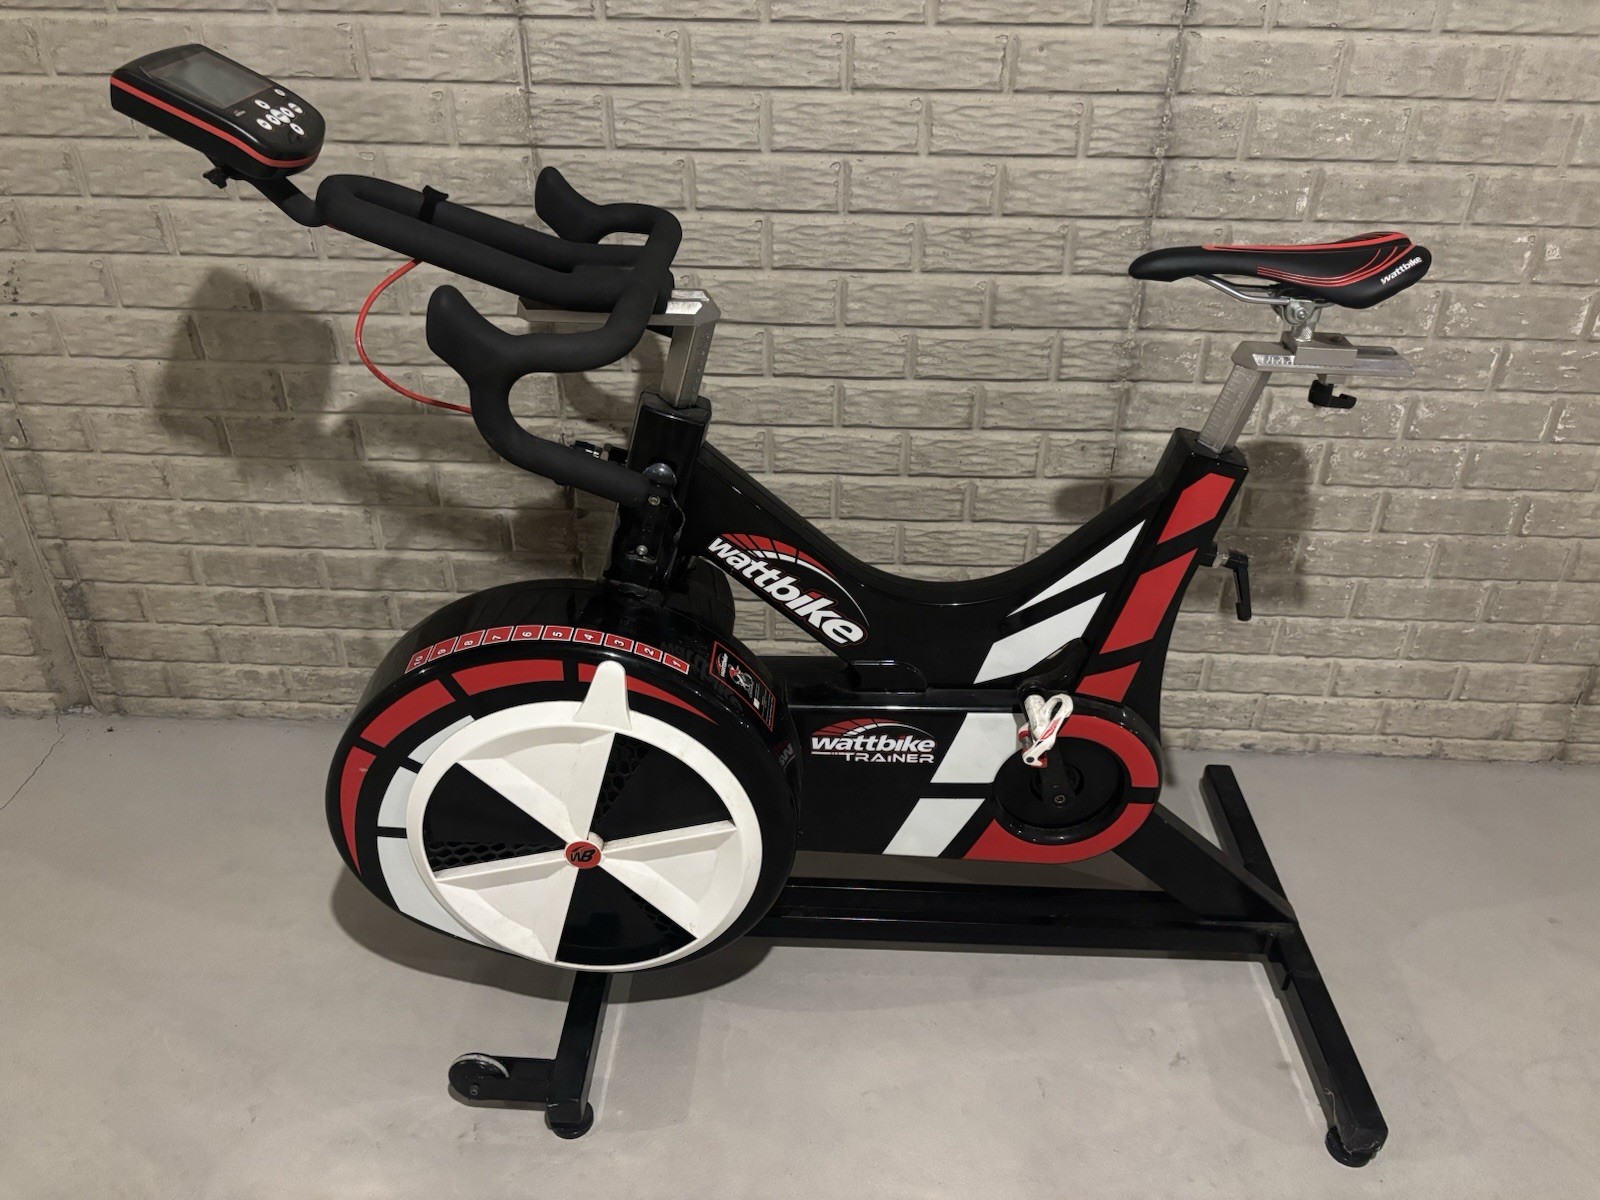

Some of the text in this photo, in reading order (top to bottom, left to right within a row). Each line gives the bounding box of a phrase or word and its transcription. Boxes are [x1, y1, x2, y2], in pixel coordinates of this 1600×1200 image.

[1380, 256, 1422, 285] wattbike
[707, 537, 864, 644] wattbike
[413, 655, 423, 666] 10
[643, 647, 654, 656] 2
[672, 660, 682, 668] 1
[811, 735, 936, 752] wattbike
